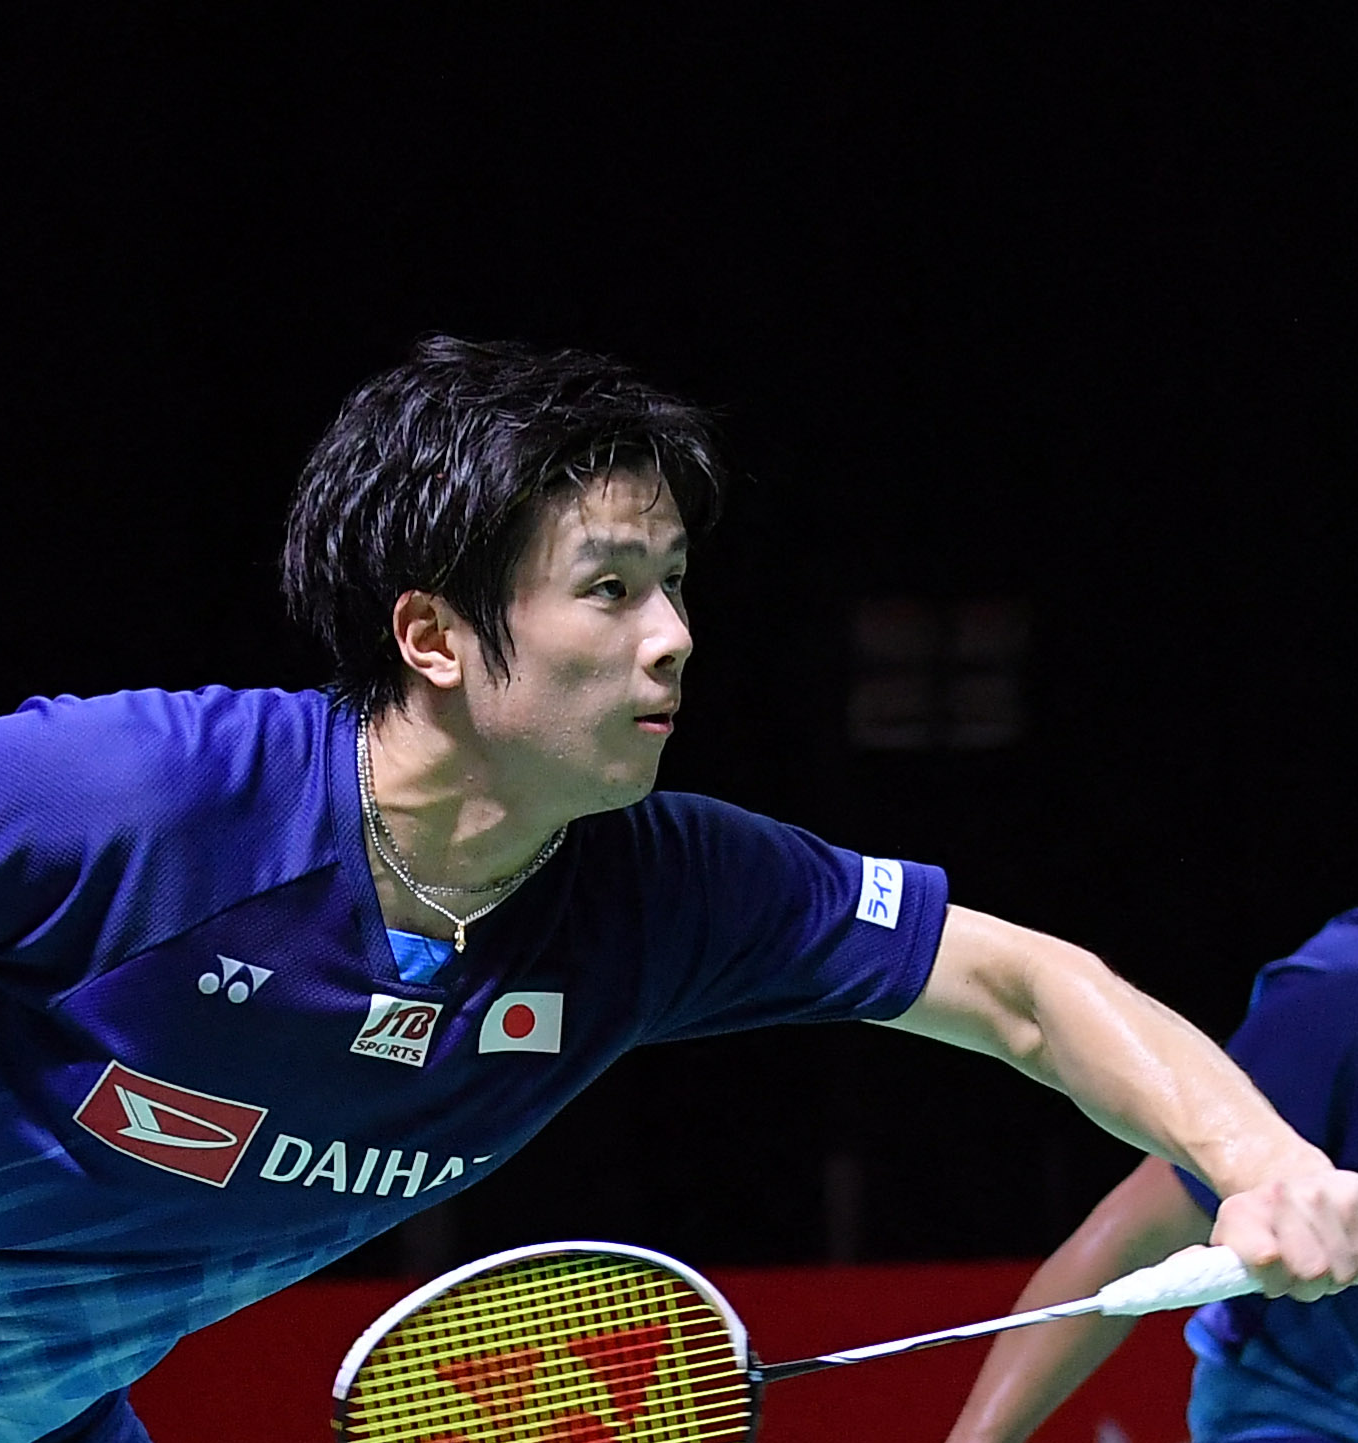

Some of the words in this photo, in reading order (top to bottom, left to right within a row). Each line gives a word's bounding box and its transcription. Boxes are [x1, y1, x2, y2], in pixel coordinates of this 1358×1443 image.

[866, 865, 893, 919] ライフ
[359, 1002, 438, 1041] JTB
[353, 1039, 423, 1063] SPORTS
[259, 1133, 497, 1198] DAIHA
